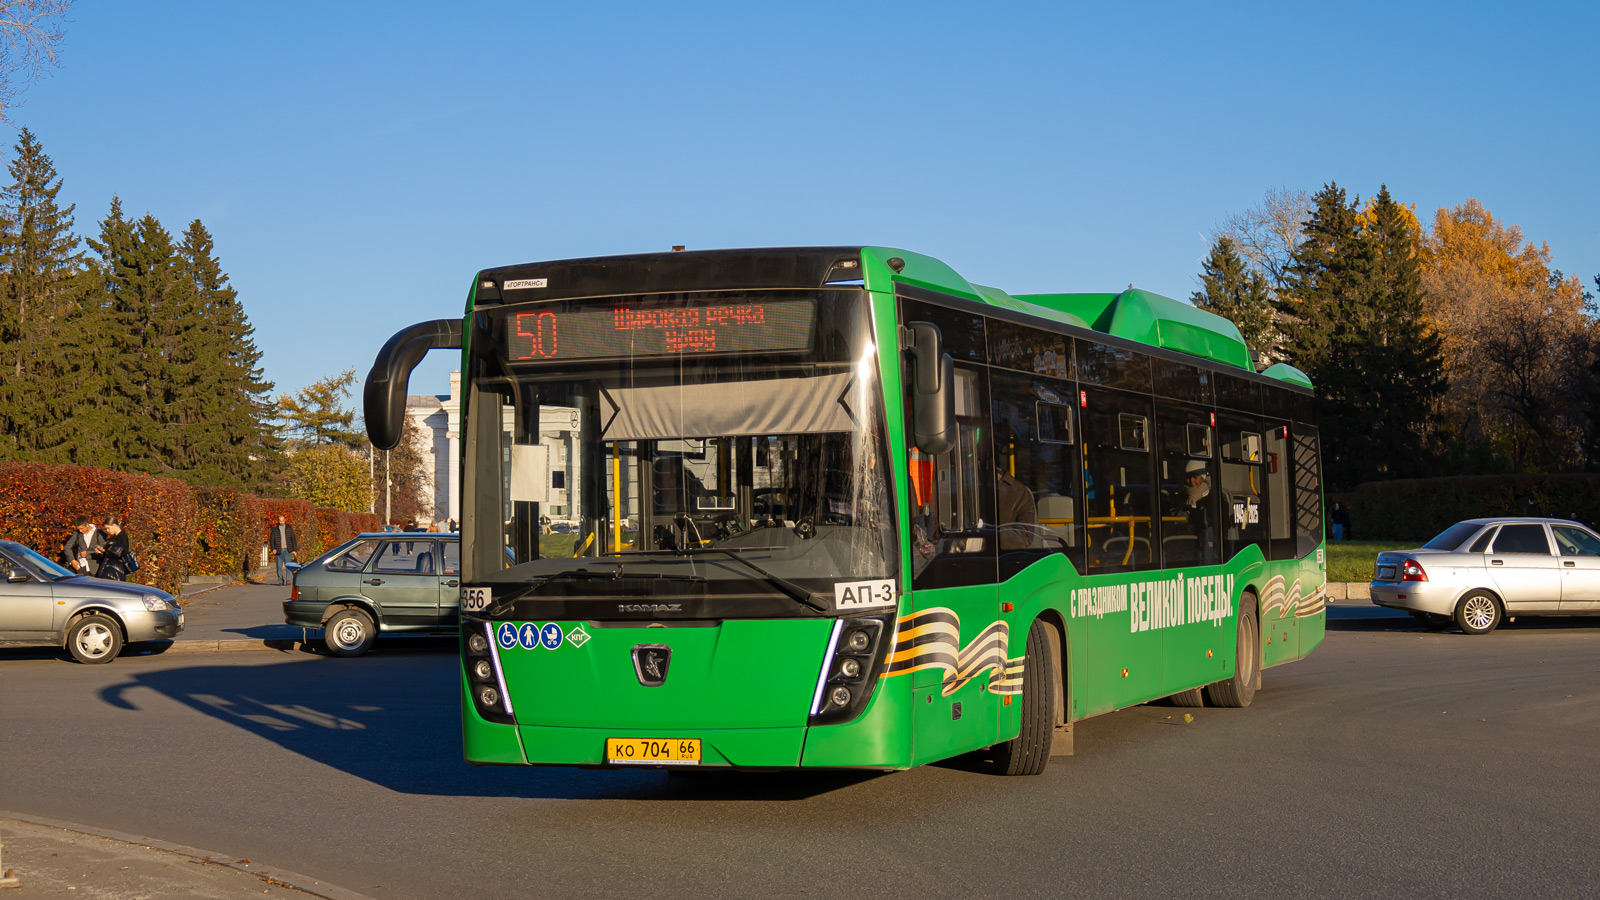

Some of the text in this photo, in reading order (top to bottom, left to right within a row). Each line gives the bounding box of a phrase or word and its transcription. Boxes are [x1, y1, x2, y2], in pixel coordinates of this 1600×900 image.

[507, 280, 543, 288] «ГОРТРАНС»
[614, 308, 699, 330] Широкая
[517, 312, 557, 359] 50
[841, 584, 892, 605] АП-3
[1070, 572, 1234, 633] С ПРАЗДНИКОМ ВЕЛИКОЙ ПОБЕДЫ!
[618, 604, 682, 612] KAMAZ
[571, 633, 585, 641] КПГ
[641, 741, 669, 758] 704
[680, 741, 694, 753] 66
